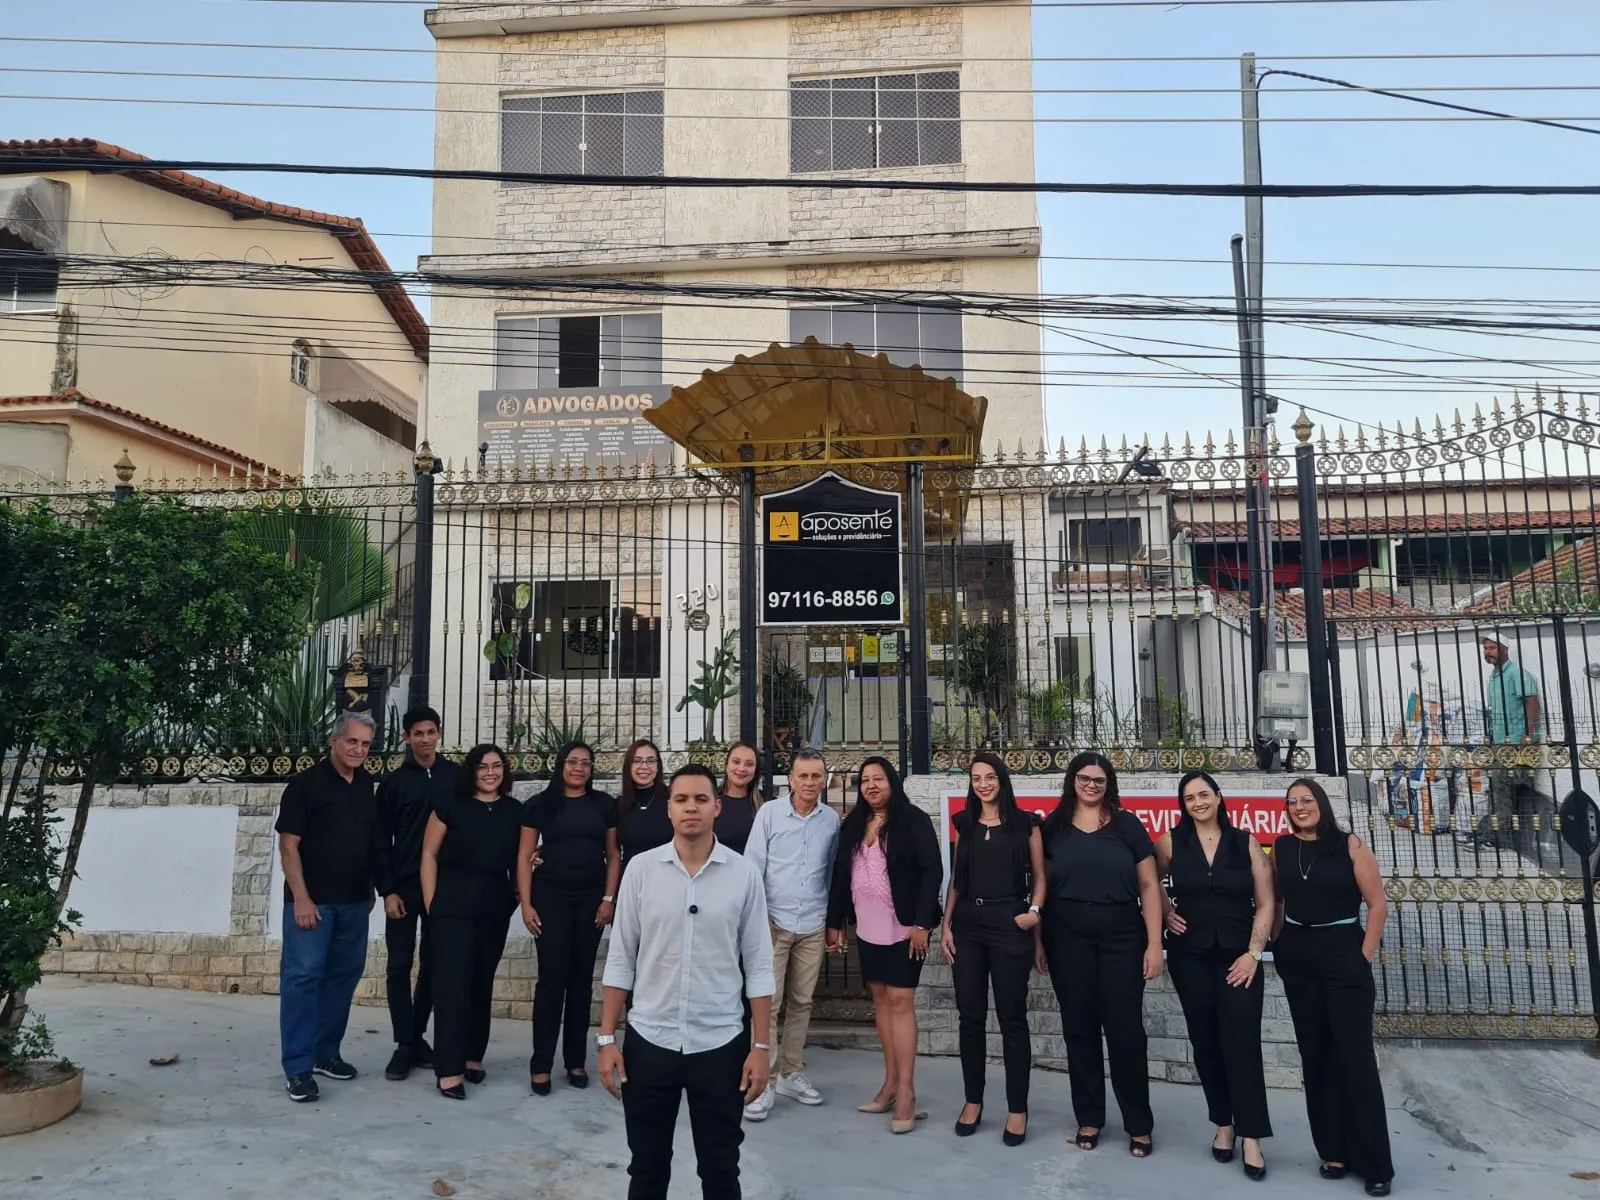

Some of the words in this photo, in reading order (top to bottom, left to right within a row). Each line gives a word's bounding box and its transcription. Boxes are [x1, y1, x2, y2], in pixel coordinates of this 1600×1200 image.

[523, 393, 653, 414] ADVOGADOS
[801, 509, 893, 533] aposente
[675, 583, 720, 612] 220
[768, 590, 878, 608] 97116-8856
